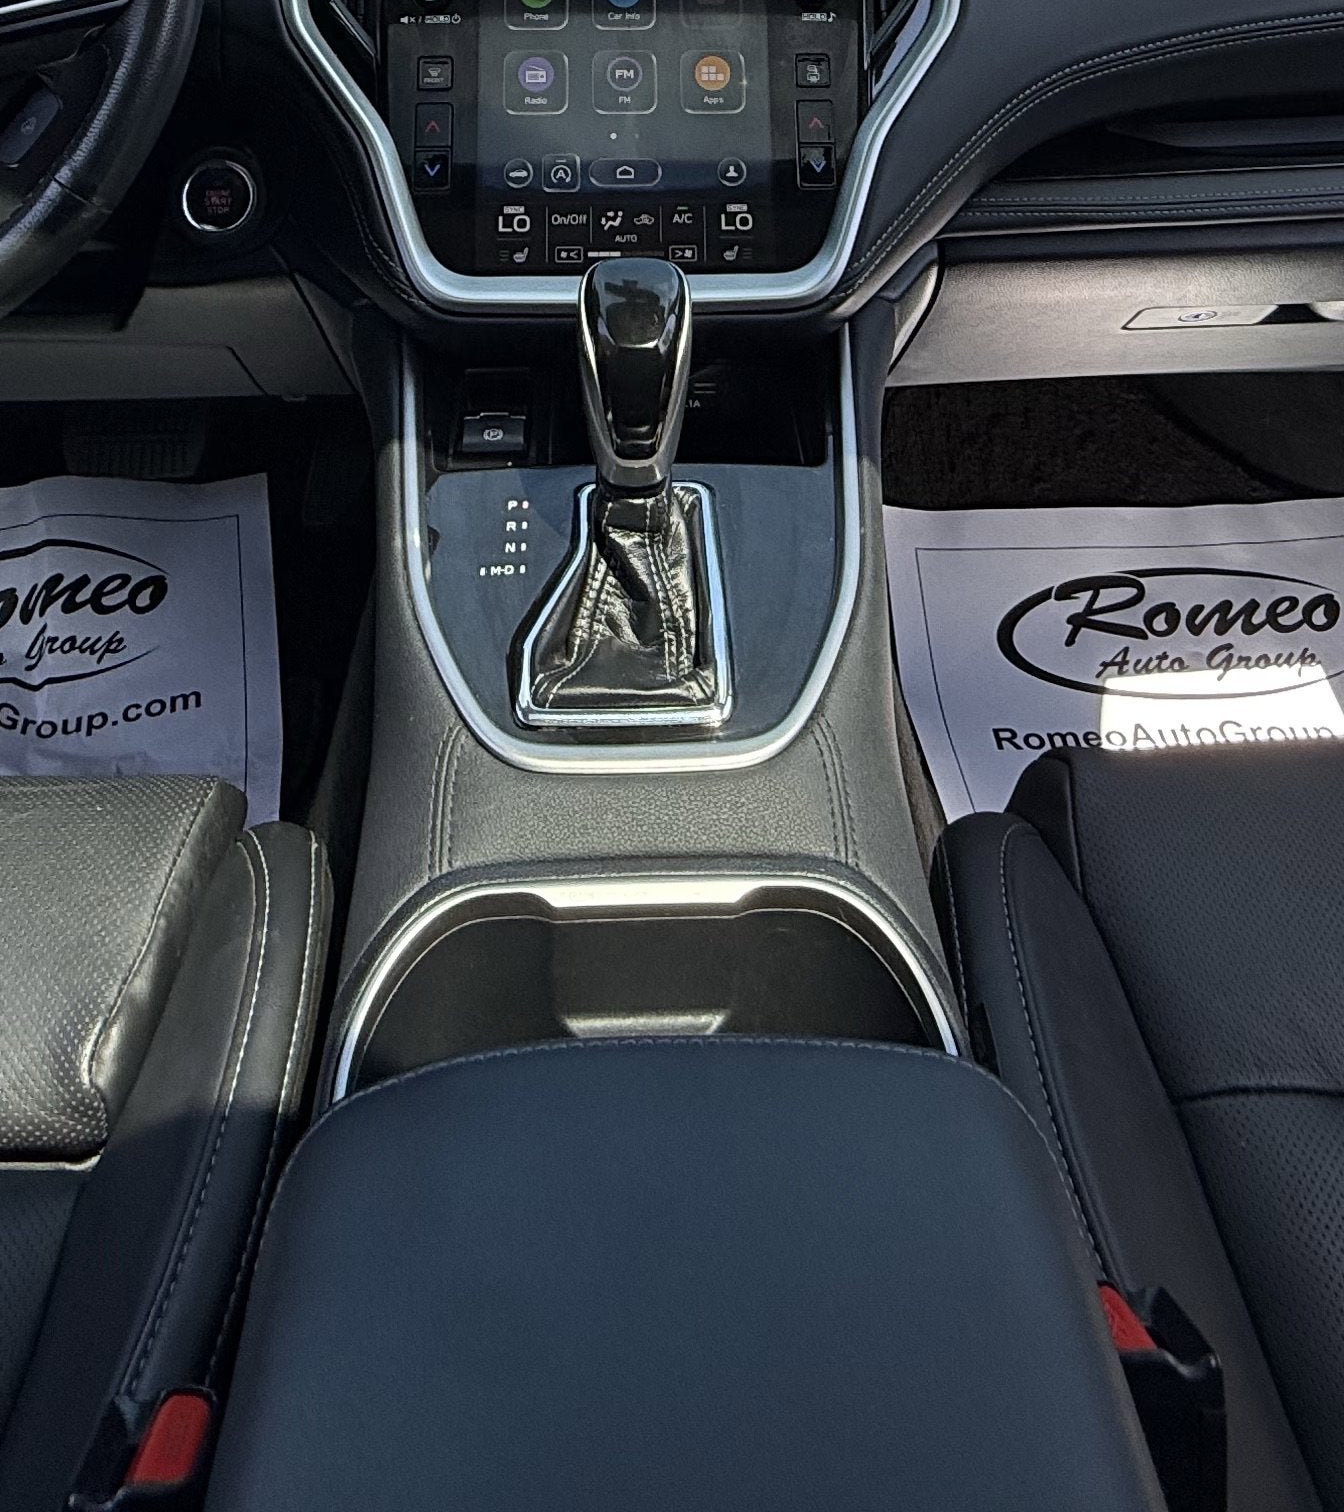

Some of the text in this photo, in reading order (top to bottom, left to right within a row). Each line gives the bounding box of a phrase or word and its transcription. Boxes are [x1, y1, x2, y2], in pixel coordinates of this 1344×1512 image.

[523, 12, 549, 21] Phone
[607, 12, 623, 21] Car
[614, 69, 635, 79] FM
[524, 96, 548, 105] Radio
[618, 96, 632, 104] FM
[703, 96, 725, 106] Apps
[497, 214, 531, 232] LO
[551, 213, 588, 225] On/Off
[672, 213, 694, 225] A/C
[720, 212, 754, 231] LO
[614, 234, 638, 243] AUTO
[684, 399, 701, 409] .1A
[507, 500, 518, 511] P
[506, 521, 517, 531] R
[504, 542, 516, 553] N
[1053, 574, 1341, 648] Romeo
[24, 622, 127, 672] Group
[1094, 642, 1322, 681] Auto Group
